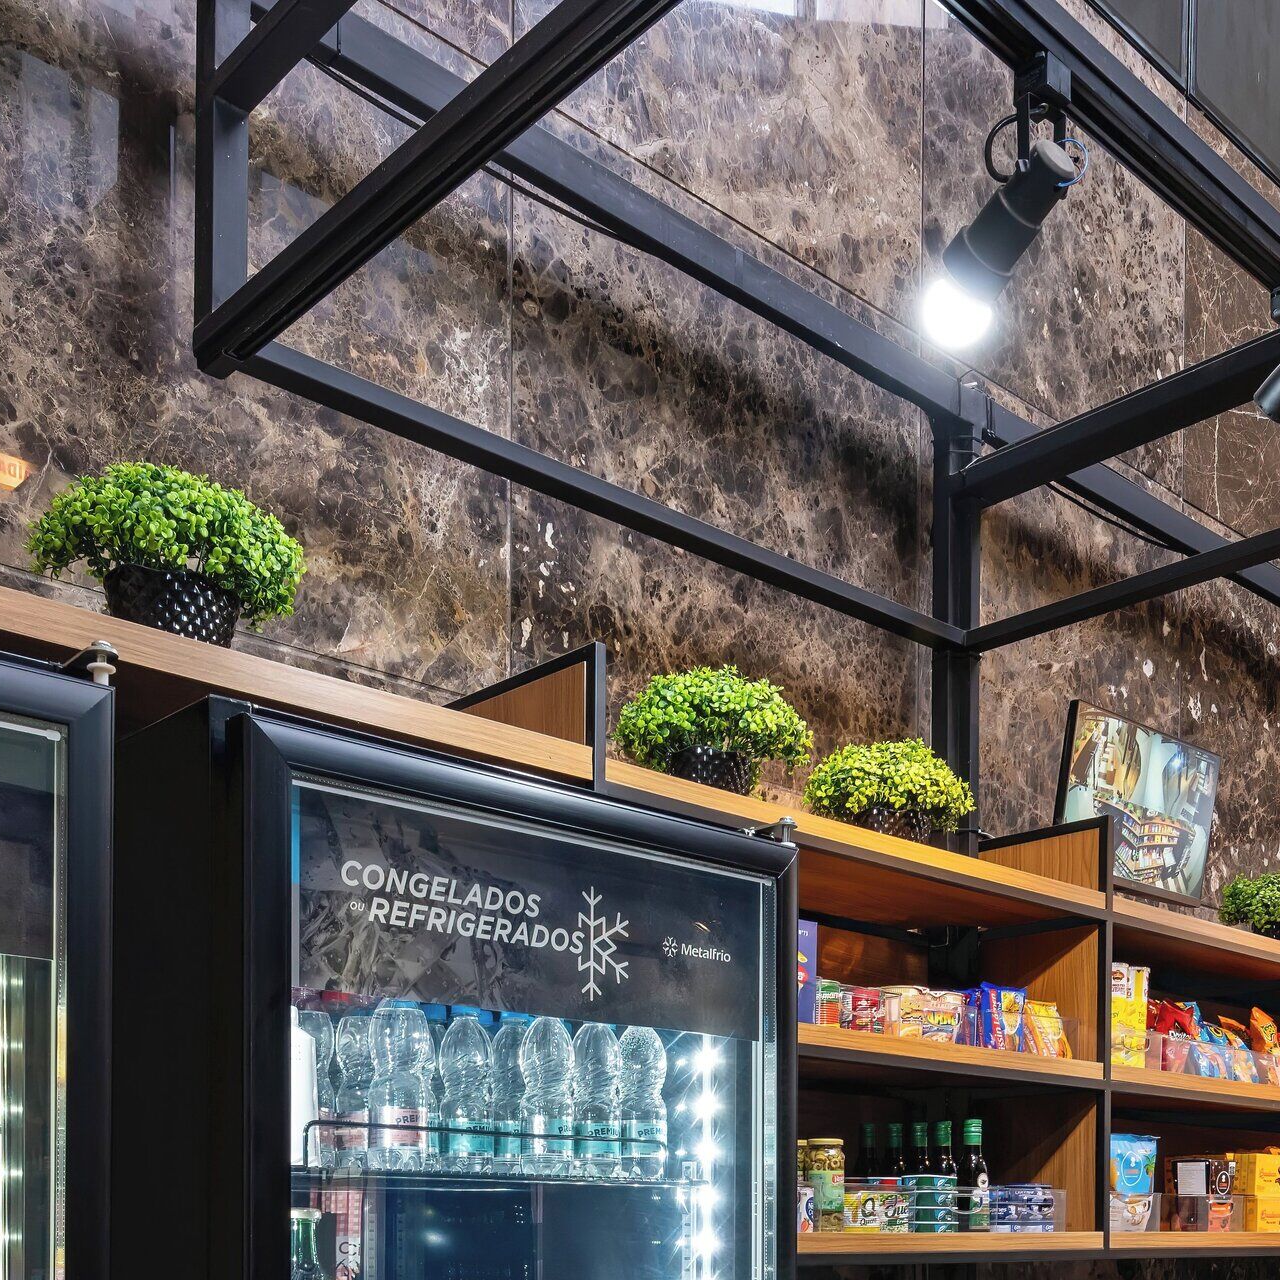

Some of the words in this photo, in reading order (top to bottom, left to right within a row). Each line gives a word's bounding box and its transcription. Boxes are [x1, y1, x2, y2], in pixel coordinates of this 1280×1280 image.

[340, 858, 541, 918] CONGELADOS
[349, 901, 365, 912] OU
[368, 896, 585, 955] REFRIGERADOS
[681, 942, 732, 962] Metalfrio
